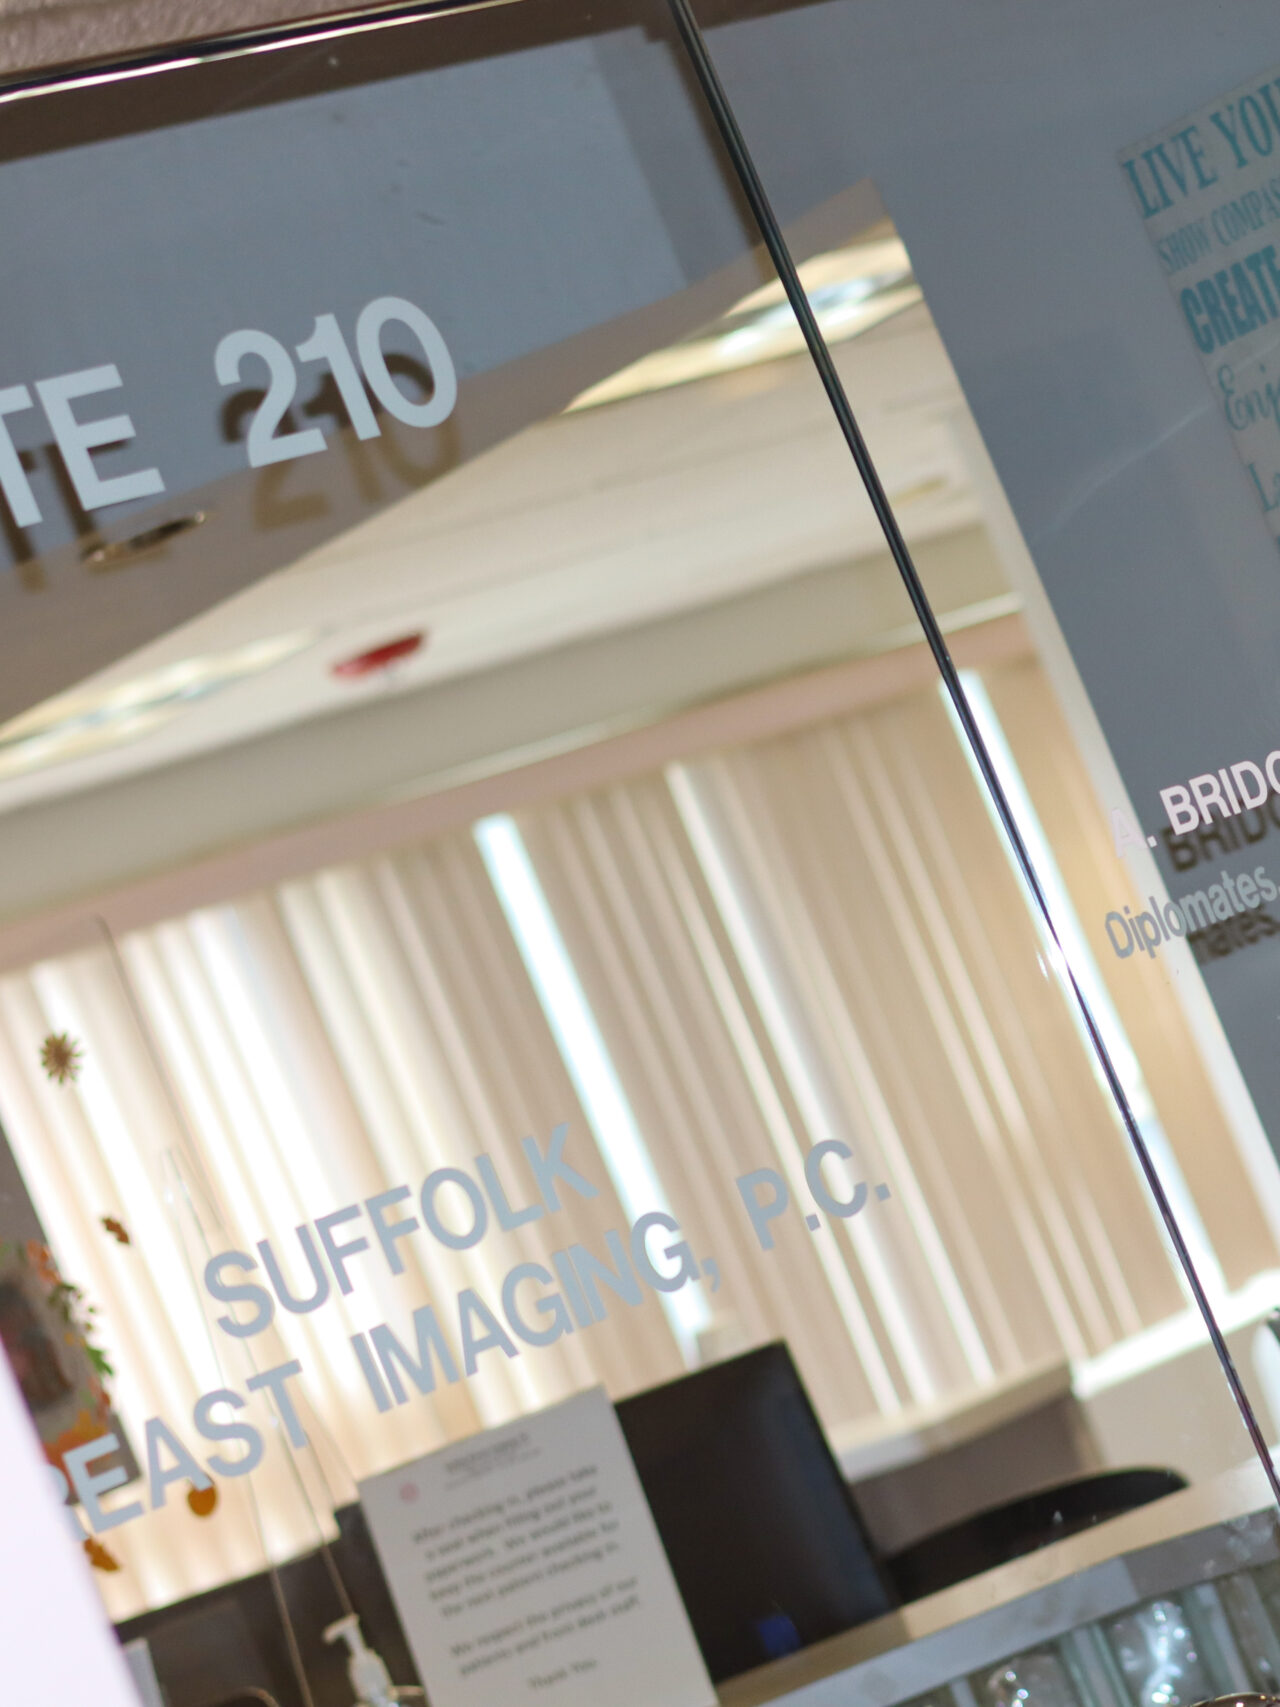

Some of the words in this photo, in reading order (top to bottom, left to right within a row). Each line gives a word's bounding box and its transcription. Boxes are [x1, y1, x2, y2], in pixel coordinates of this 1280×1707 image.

[1122, 125, 1218, 219] LIVE
[1157, 217, 1211, 276] SHOW
[214, 296, 457, 468] 210
[204, 1122, 600, 1338] SUFFOLK
[351, 1212, 722, 1413] IMAGING,
[736, 1139, 891, 1252] P.C.
